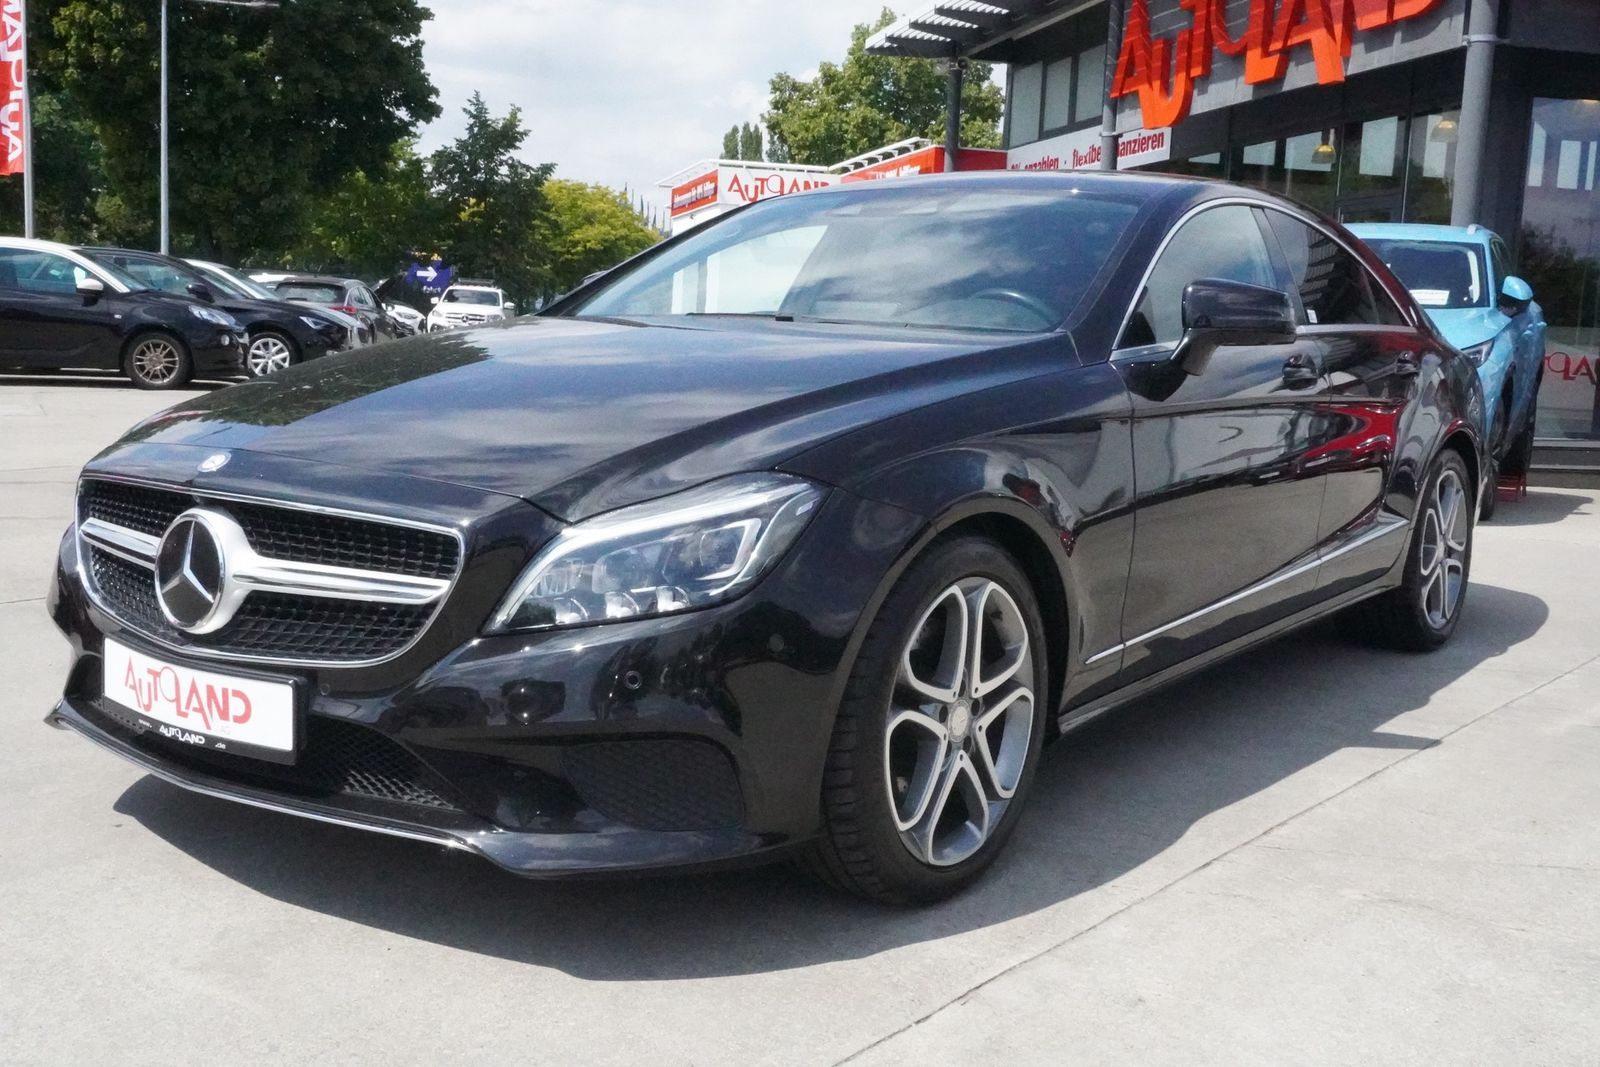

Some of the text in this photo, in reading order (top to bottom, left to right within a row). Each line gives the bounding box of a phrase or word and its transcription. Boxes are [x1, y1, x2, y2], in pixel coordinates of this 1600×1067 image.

[1072, 145, 1102, 167] flexibe
[125, 655, 252, 730] AUTOLAND
[159, 724, 205, 744] AUTOLAND
